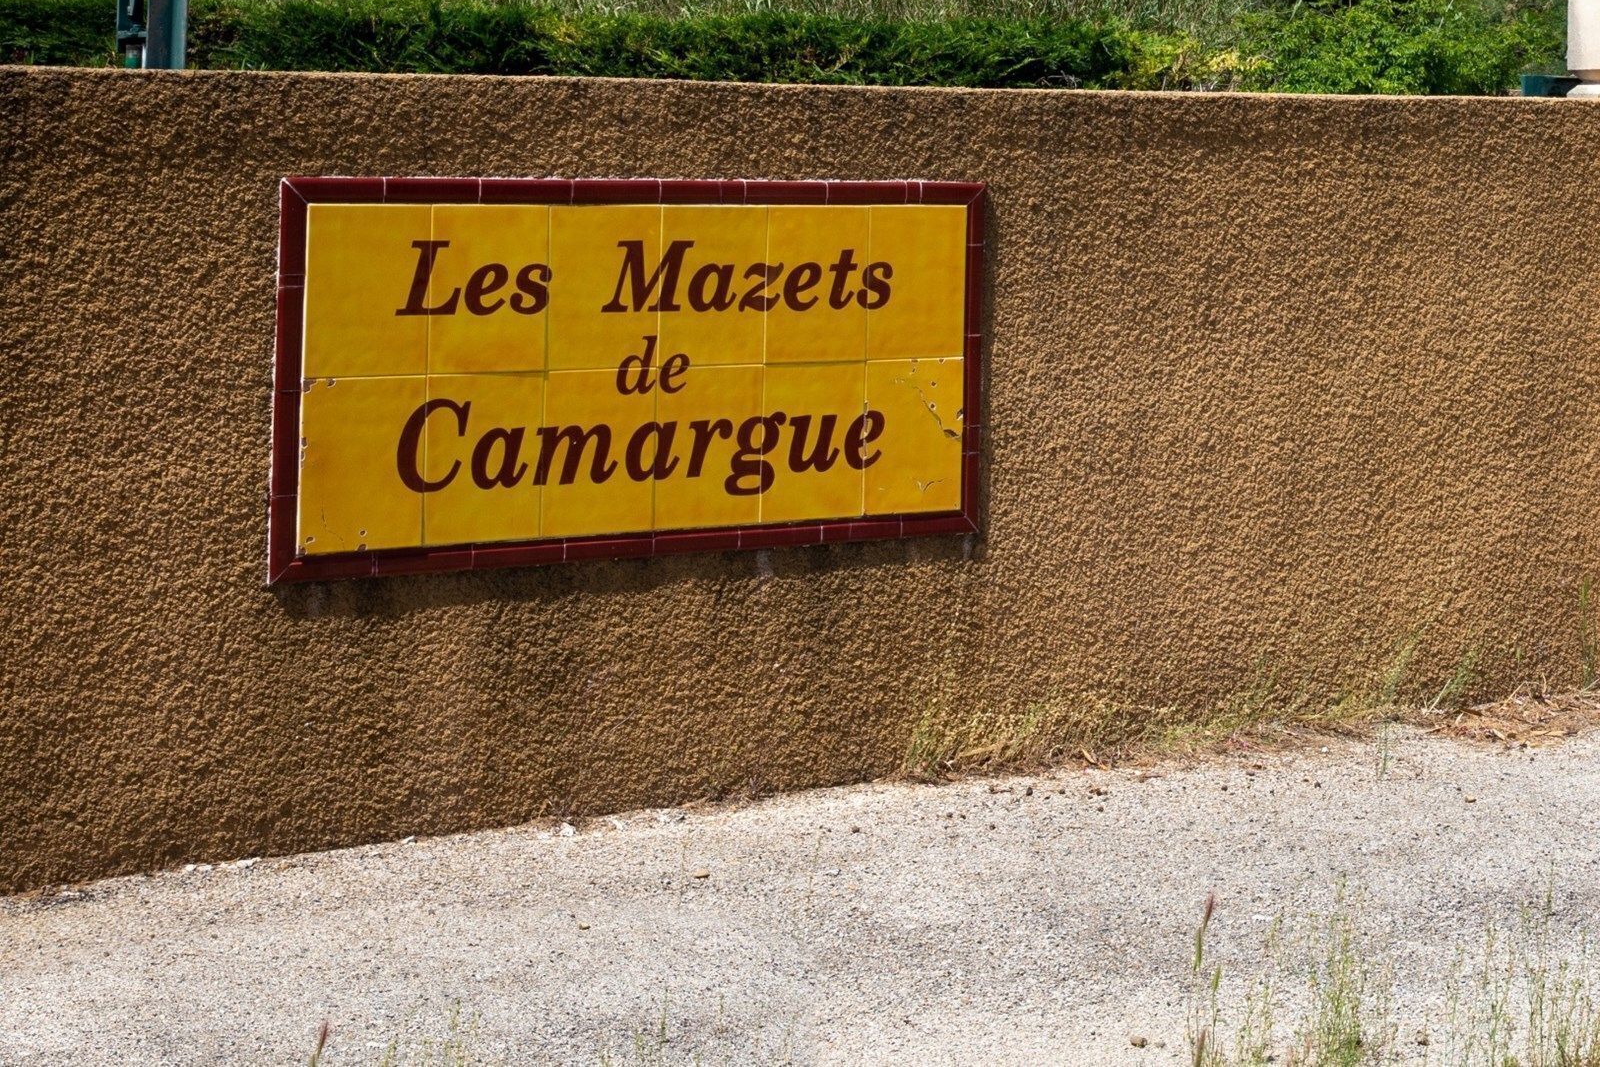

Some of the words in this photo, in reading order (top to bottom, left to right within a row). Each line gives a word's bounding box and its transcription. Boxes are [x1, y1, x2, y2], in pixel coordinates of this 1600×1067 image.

[396, 240, 552, 316] Les
[601, 240, 894, 313] Mazets
[616, 335, 691, 396] de
[397, 397, 887, 496] Camargue
